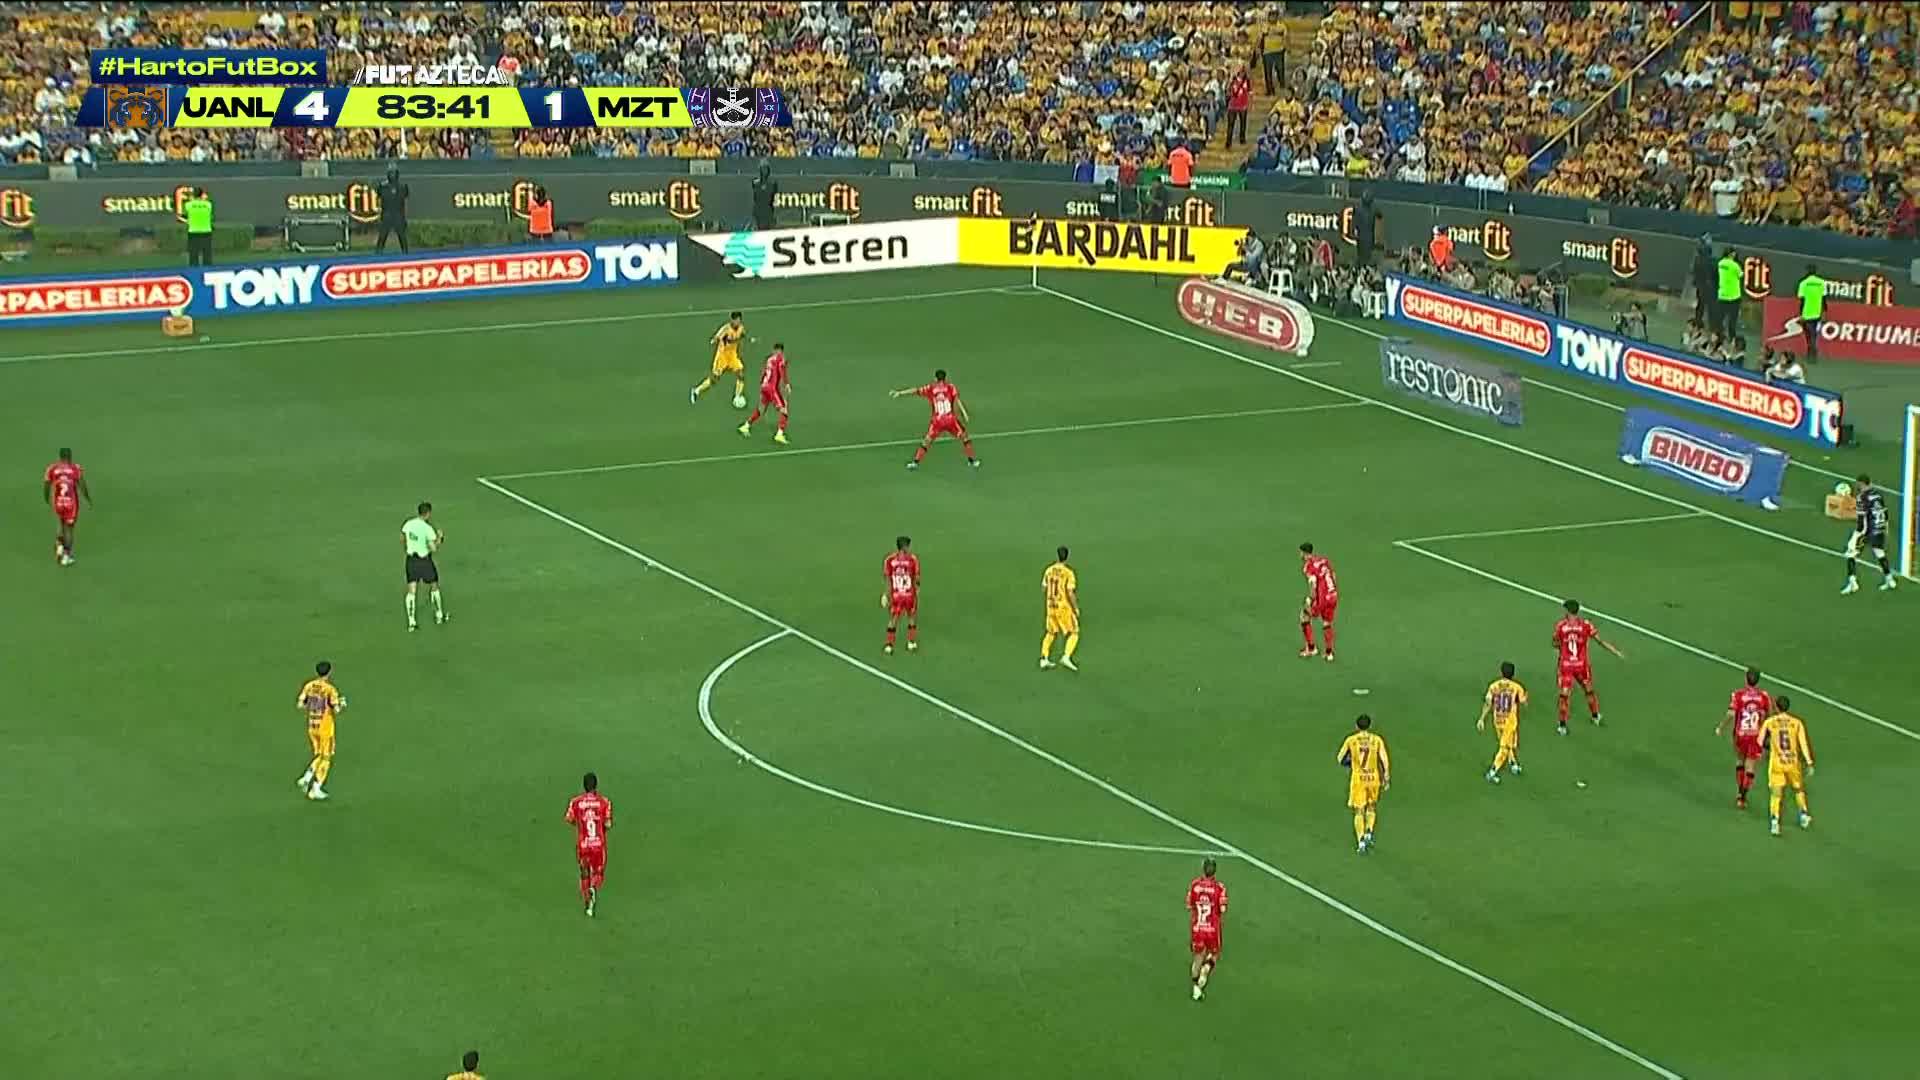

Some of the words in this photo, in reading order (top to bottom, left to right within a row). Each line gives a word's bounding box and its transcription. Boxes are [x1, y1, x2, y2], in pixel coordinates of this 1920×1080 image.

[0, 189, 35, 217] fit
[104, 194, 174, 213] smart
[287, 194, 346, 209] smart
[349, 185, 382, 212] fit
[454, 190, 511, 208] smart
[610, 190, 666, 207] smart
[670, 183, 701, 209] fit
[773, 192, 826, 208] smart
[830, 184, 860, 211] fit
[914, 194, 969, 211] smart
[973, 187, 1002, 215] fit
[1184, 198, 1214, 226] fit
[1287, 210, 1339, 230] smart
[1009, 219, 1196, 266] BARDAHL
[1484, 221, 1511, 252] fit
[772, 234, 909, 268] Steren
[1562, 240, 1608, 261] smart
[1611, 238, 1638, 269] fit
[204, 265, 320, 309] TONY
[332, 259, 585, 291] SUPERPAPELERIAS
[595, 241, 680, 283] TON
[1743, 257, 1770, 289] fit
[1824, 279, 1863, 299] mart
[1866, 275, 1894, 306] fit
[1403, 292, 1546, 350] SUPERPAPELERIAS
[1557, 324, 1624, 380] TONY
[1627, 354, 1796, 421] SUPERPAPELERIAS
[1805, 393, 1841, 443] TO
[1651, 434, 1745, 485] BIMBO
[1360, 747, 1370, 768] 7
[586, 820, 596, 837] 9
